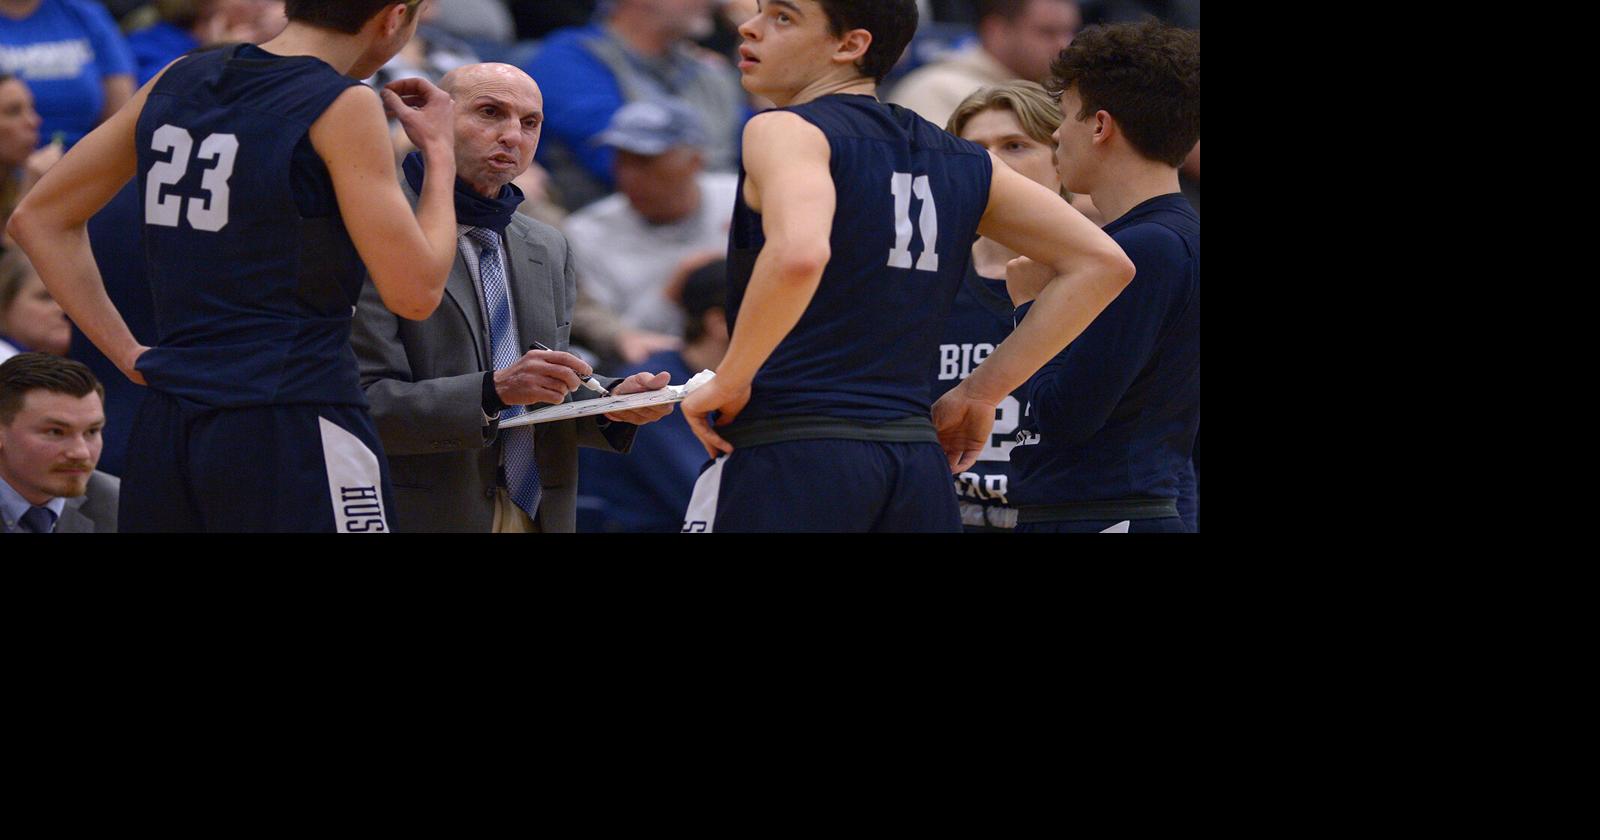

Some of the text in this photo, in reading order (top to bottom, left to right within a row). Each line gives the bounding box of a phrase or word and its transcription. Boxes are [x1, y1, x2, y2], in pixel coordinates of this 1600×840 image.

[145, 124, 239, 232] 23
[887, 171, 938, 272] 11
[938, 343, 1000, 380] BIS
[341, 486, 384, 532] HUS
